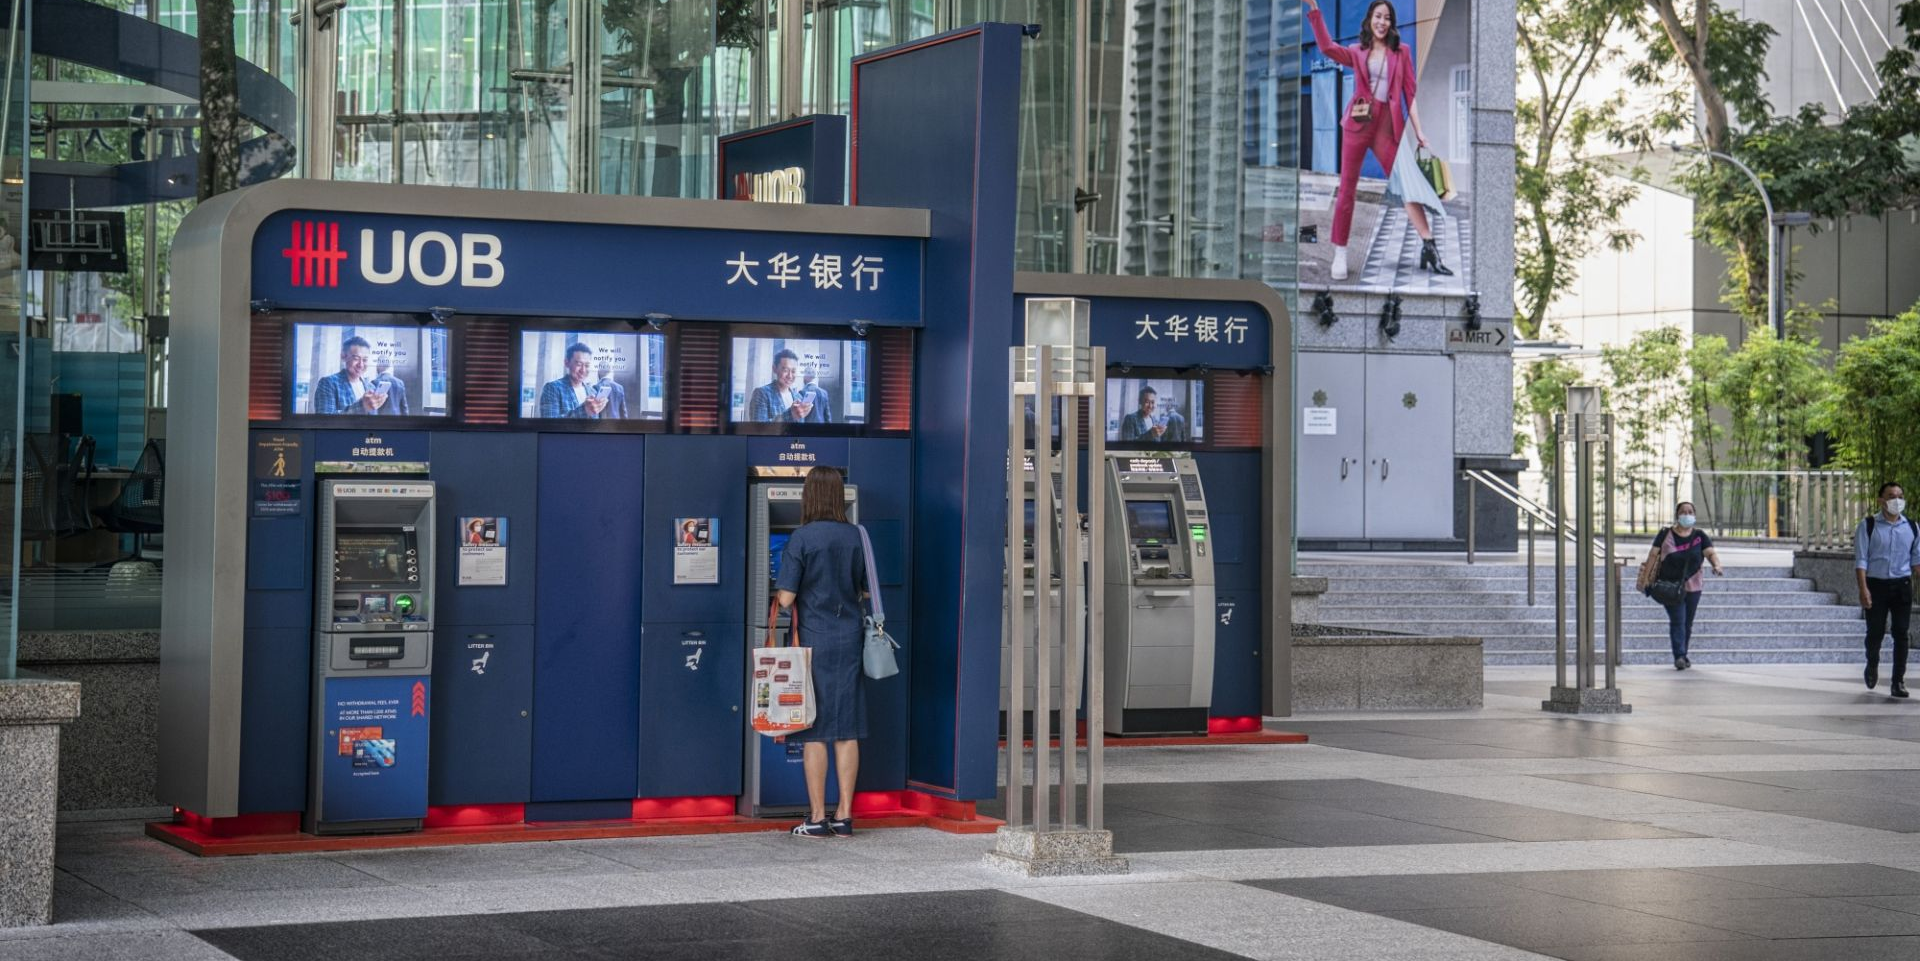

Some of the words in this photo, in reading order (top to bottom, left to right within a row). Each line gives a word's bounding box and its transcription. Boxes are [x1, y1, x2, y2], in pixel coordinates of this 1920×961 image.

[361, 228, 505, 288] UOB
[726, 251, 884, 291] 大华银行
[1135, 314, 1249, 344] 大华银行
[1465, 331, 1491, 343] MRT
[352, 447, 394, 456] 自动提款机
[779, 453, 816, 461] 自动提款机
